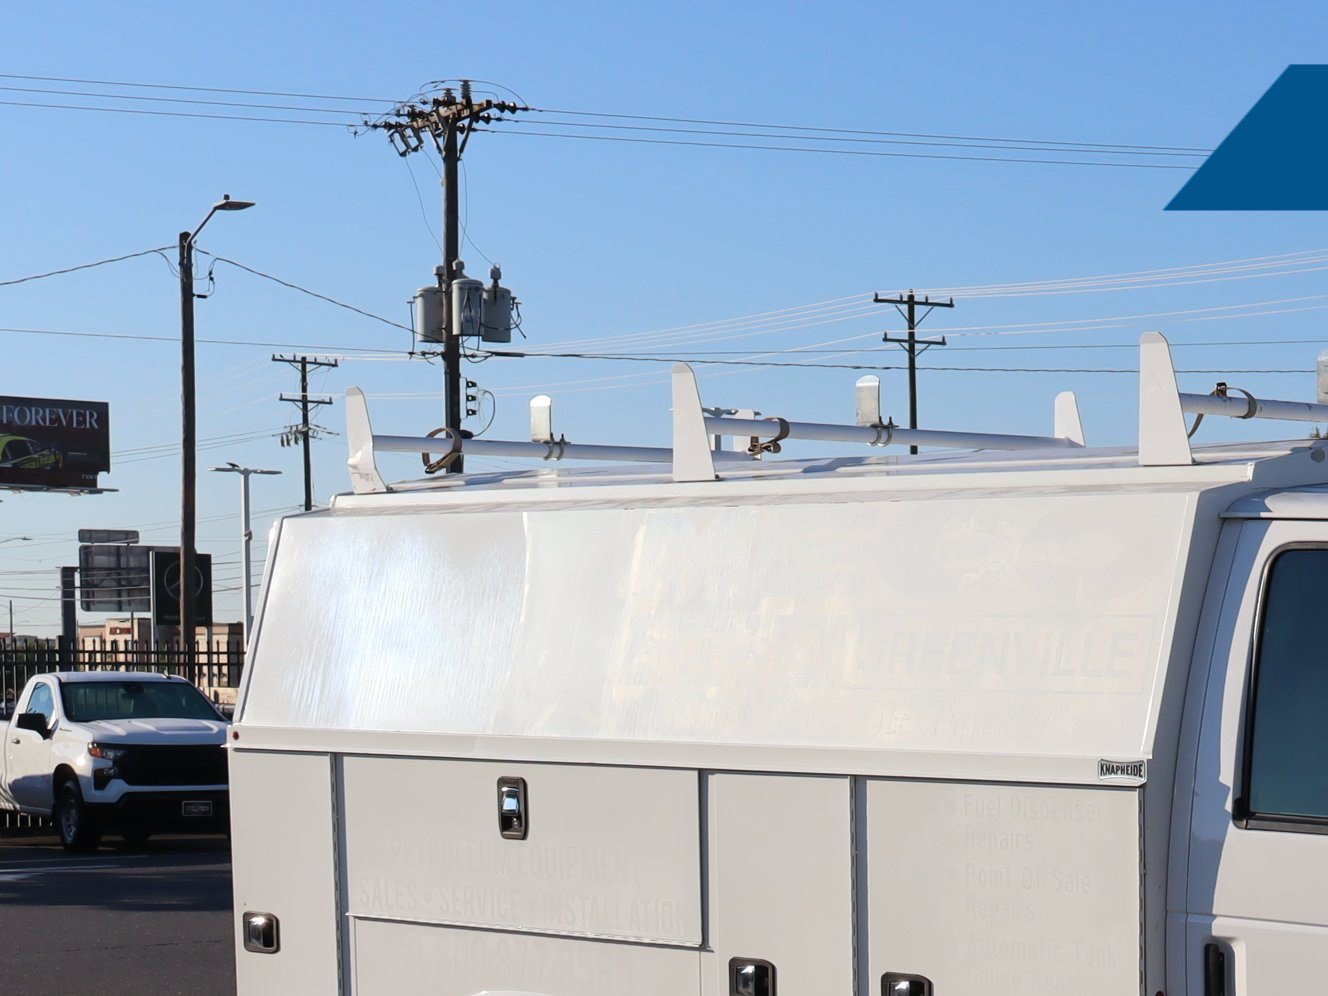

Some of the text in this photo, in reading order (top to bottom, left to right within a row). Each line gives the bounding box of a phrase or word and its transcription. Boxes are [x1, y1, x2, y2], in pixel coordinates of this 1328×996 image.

[2, 405, 98, 429] FOREVER
[1099, 762, 1144, 778] KNAPHEIDE
[361, 876, 688, 936] SALES SERVICE INSTALLATION
